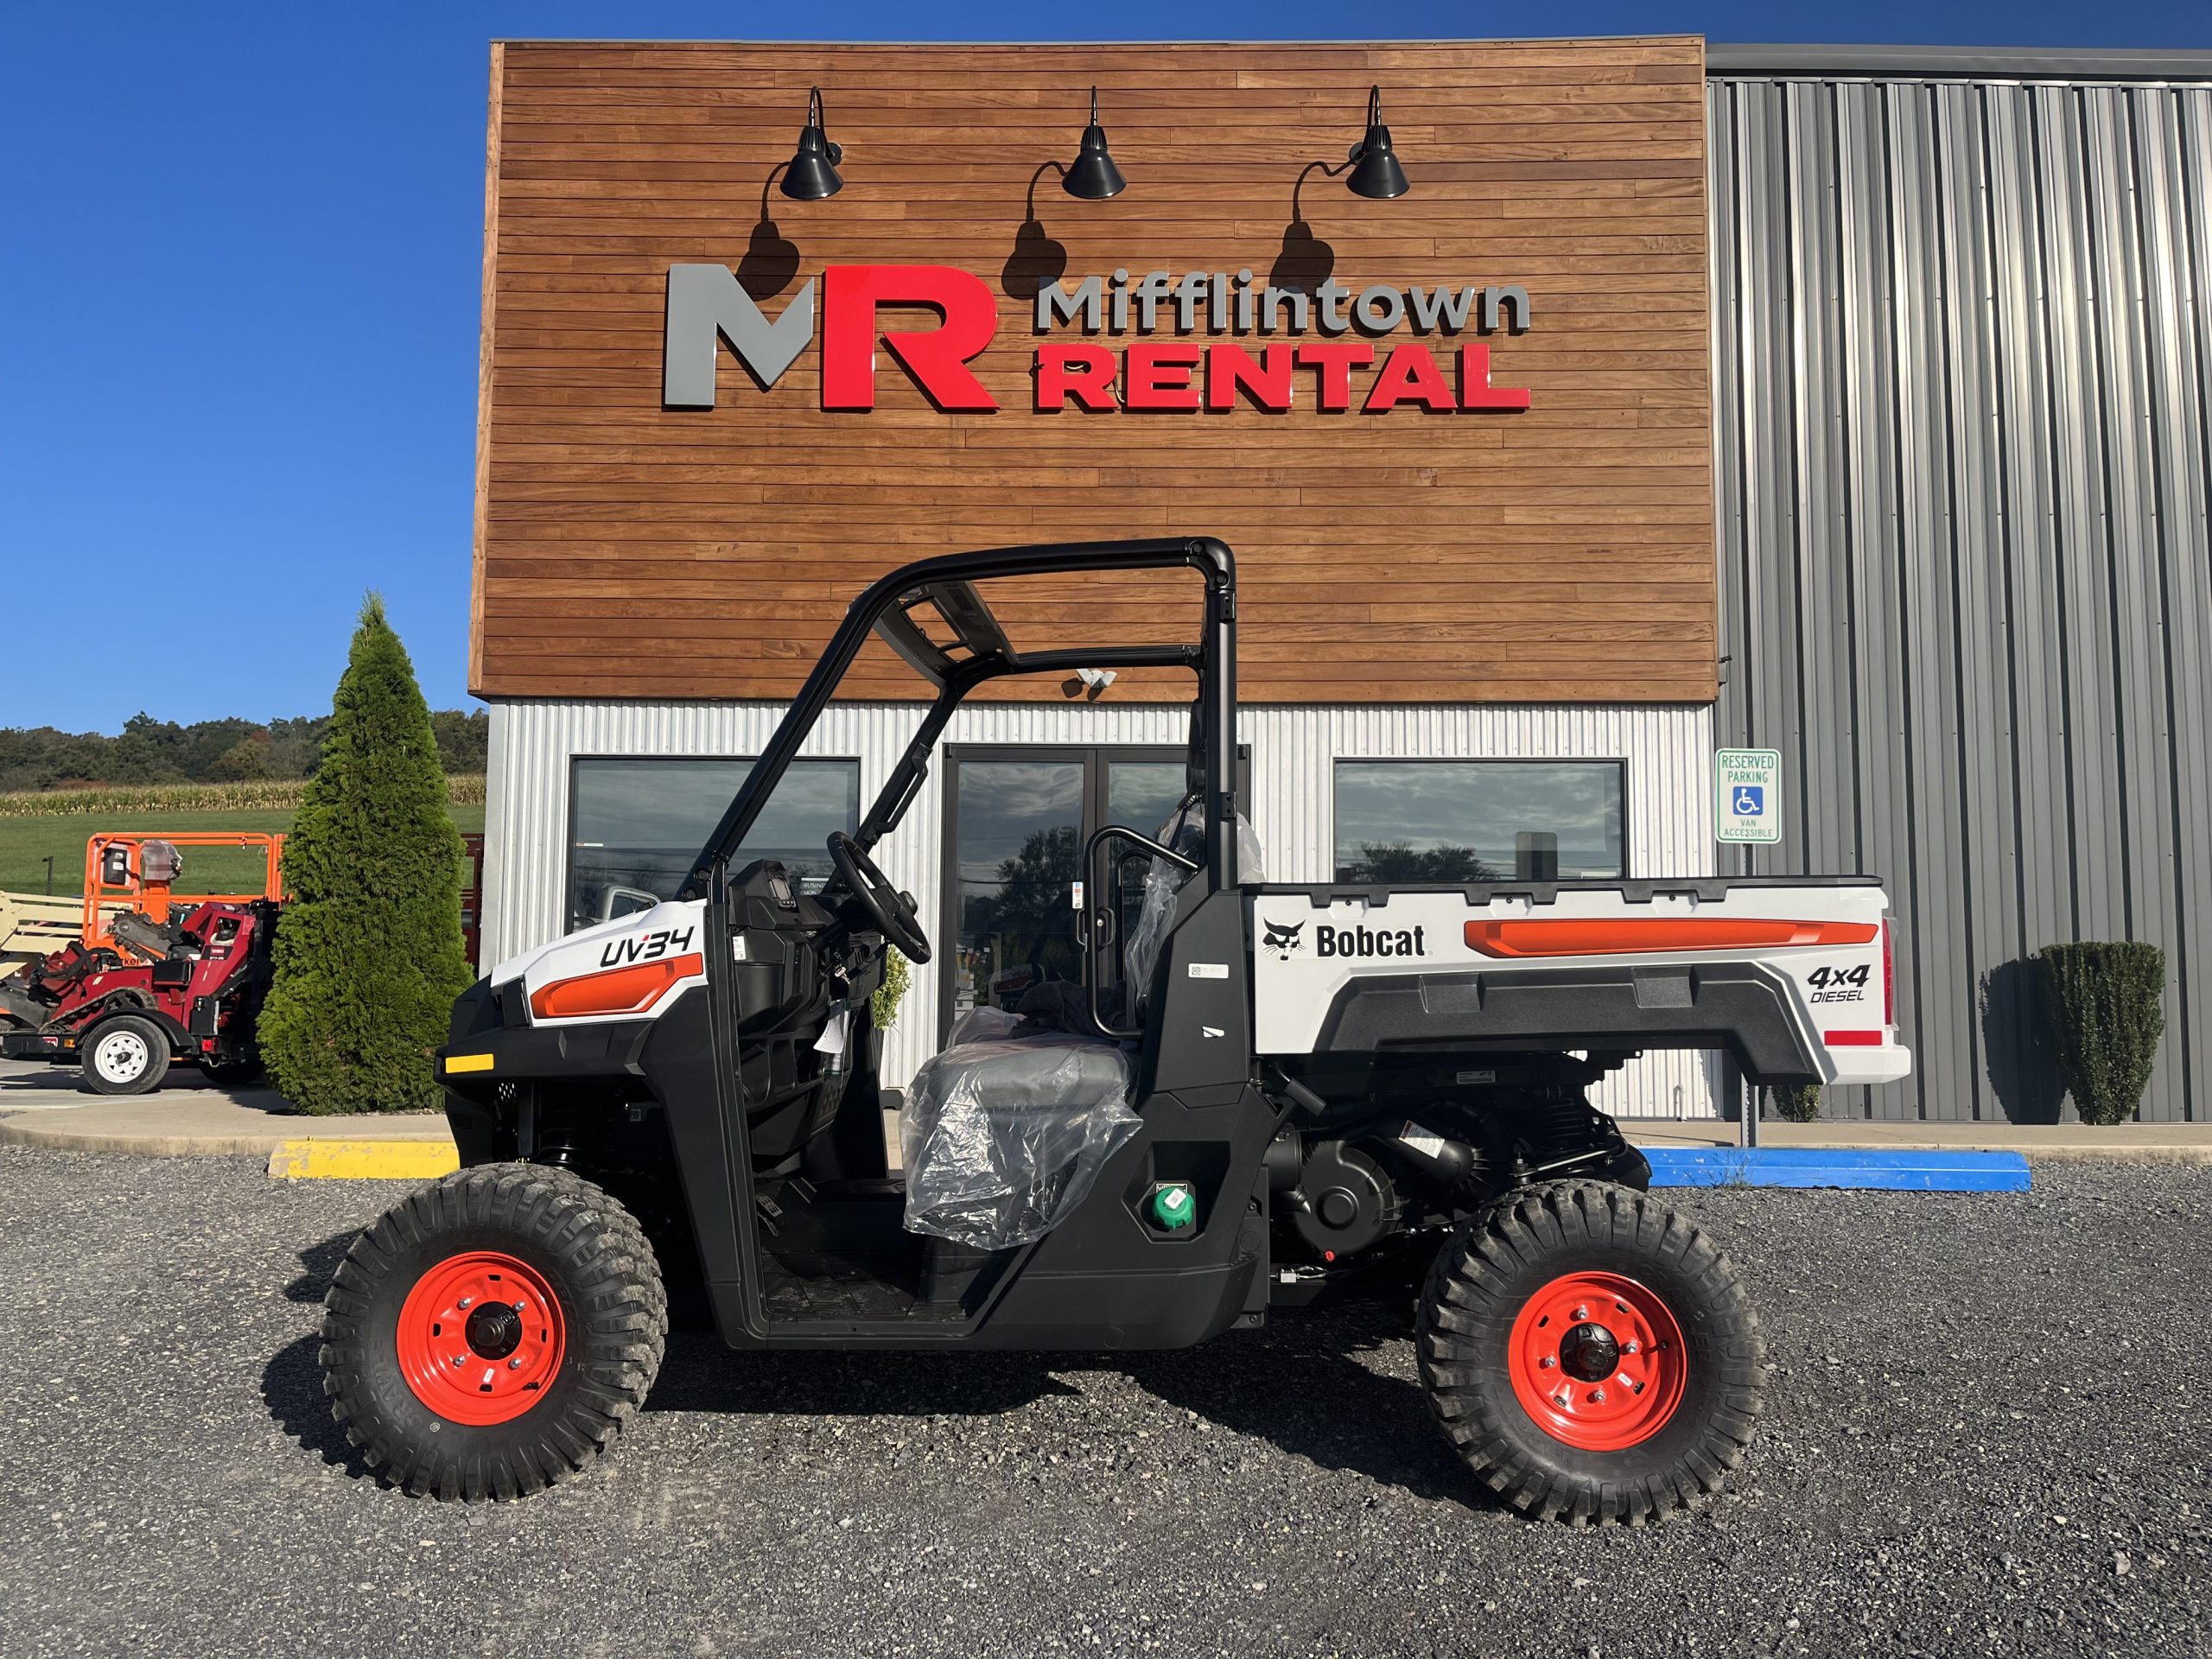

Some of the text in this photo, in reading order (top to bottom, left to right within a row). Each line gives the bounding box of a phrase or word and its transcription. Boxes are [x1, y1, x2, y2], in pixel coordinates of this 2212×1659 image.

[1039, 268, 1529, 331] Mifflintown
[665, 264, 1000, 409] MR
[1038, 343, 1531, 409] RENTAL
[1722, 755, 1774, 768] RESERVED
[1727, 771, 1769, 783] PARKING
[1724, 828, 1773, 837] ACCESSIBLE
[600, 925, 695, 968] UV34
[1317, 925, 1425, 957] Bobcat
[1807, 964, 1871, 989] 4x4
[1810, 990, 1864, 1003] DIESEL
